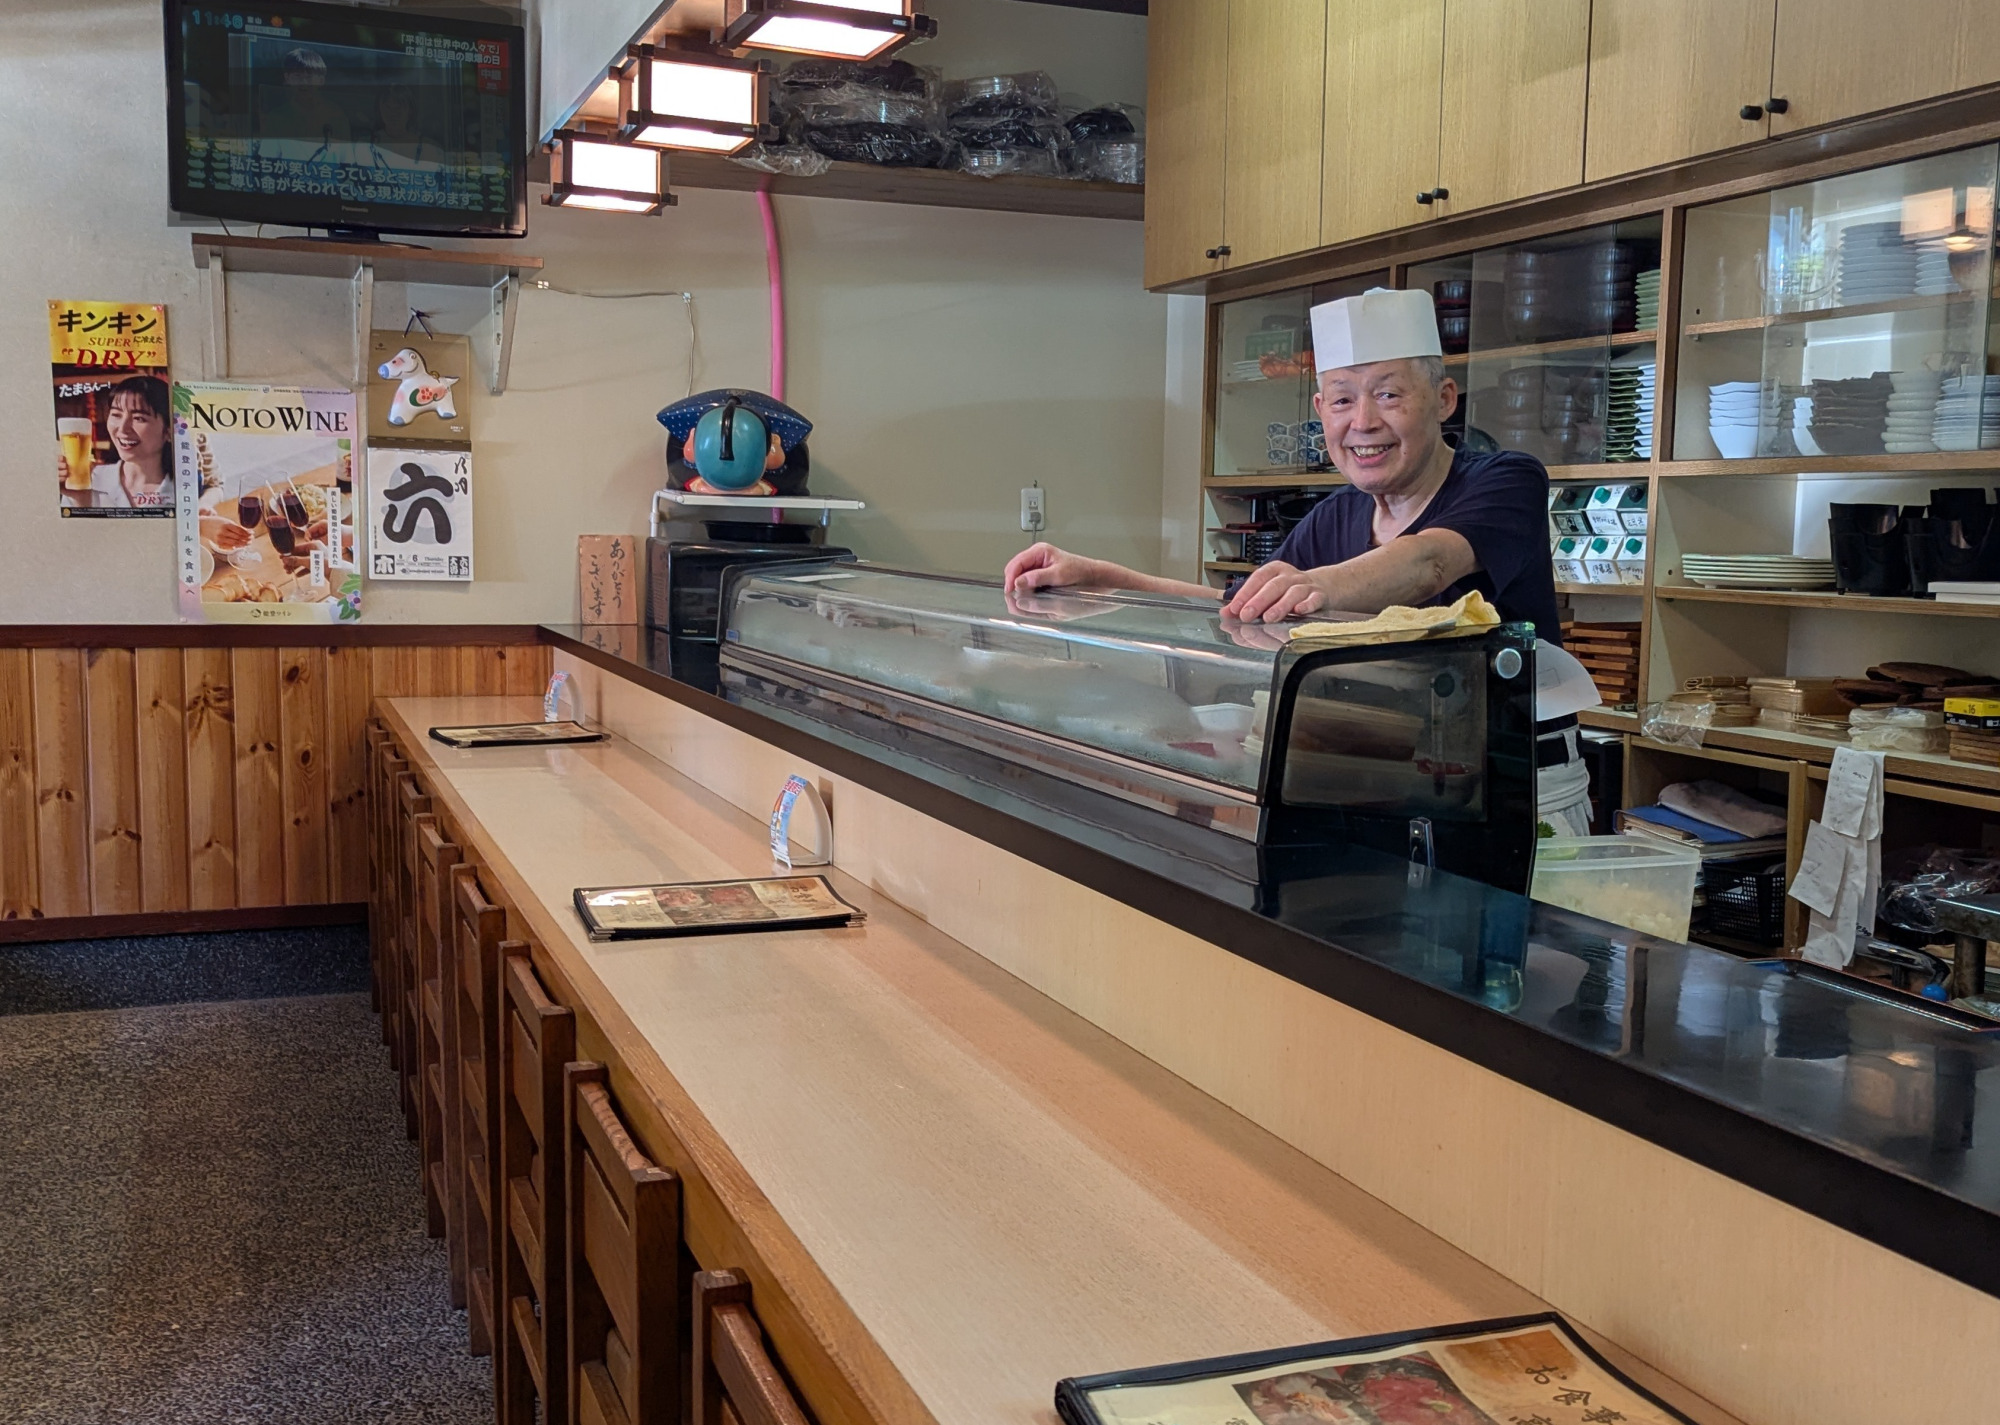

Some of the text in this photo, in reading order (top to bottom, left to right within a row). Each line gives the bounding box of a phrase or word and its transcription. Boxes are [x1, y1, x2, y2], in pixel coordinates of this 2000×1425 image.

[230, 156, 437, 188] 私たちが笑い合っているときにも
[230, 173, 471, 207] 尊い命が失われている現状があります
[58, 309, 157, 334] キンキン
[88, 337, 131, 347] SUPER
[133, 336, 164, 345] に冷えた
[191, 402, 348, 433] NOTO WINE
[181, 441, 195, 595] 能登のテロワールを食卓へ
[610, 538, 625, 609] ありがとう
